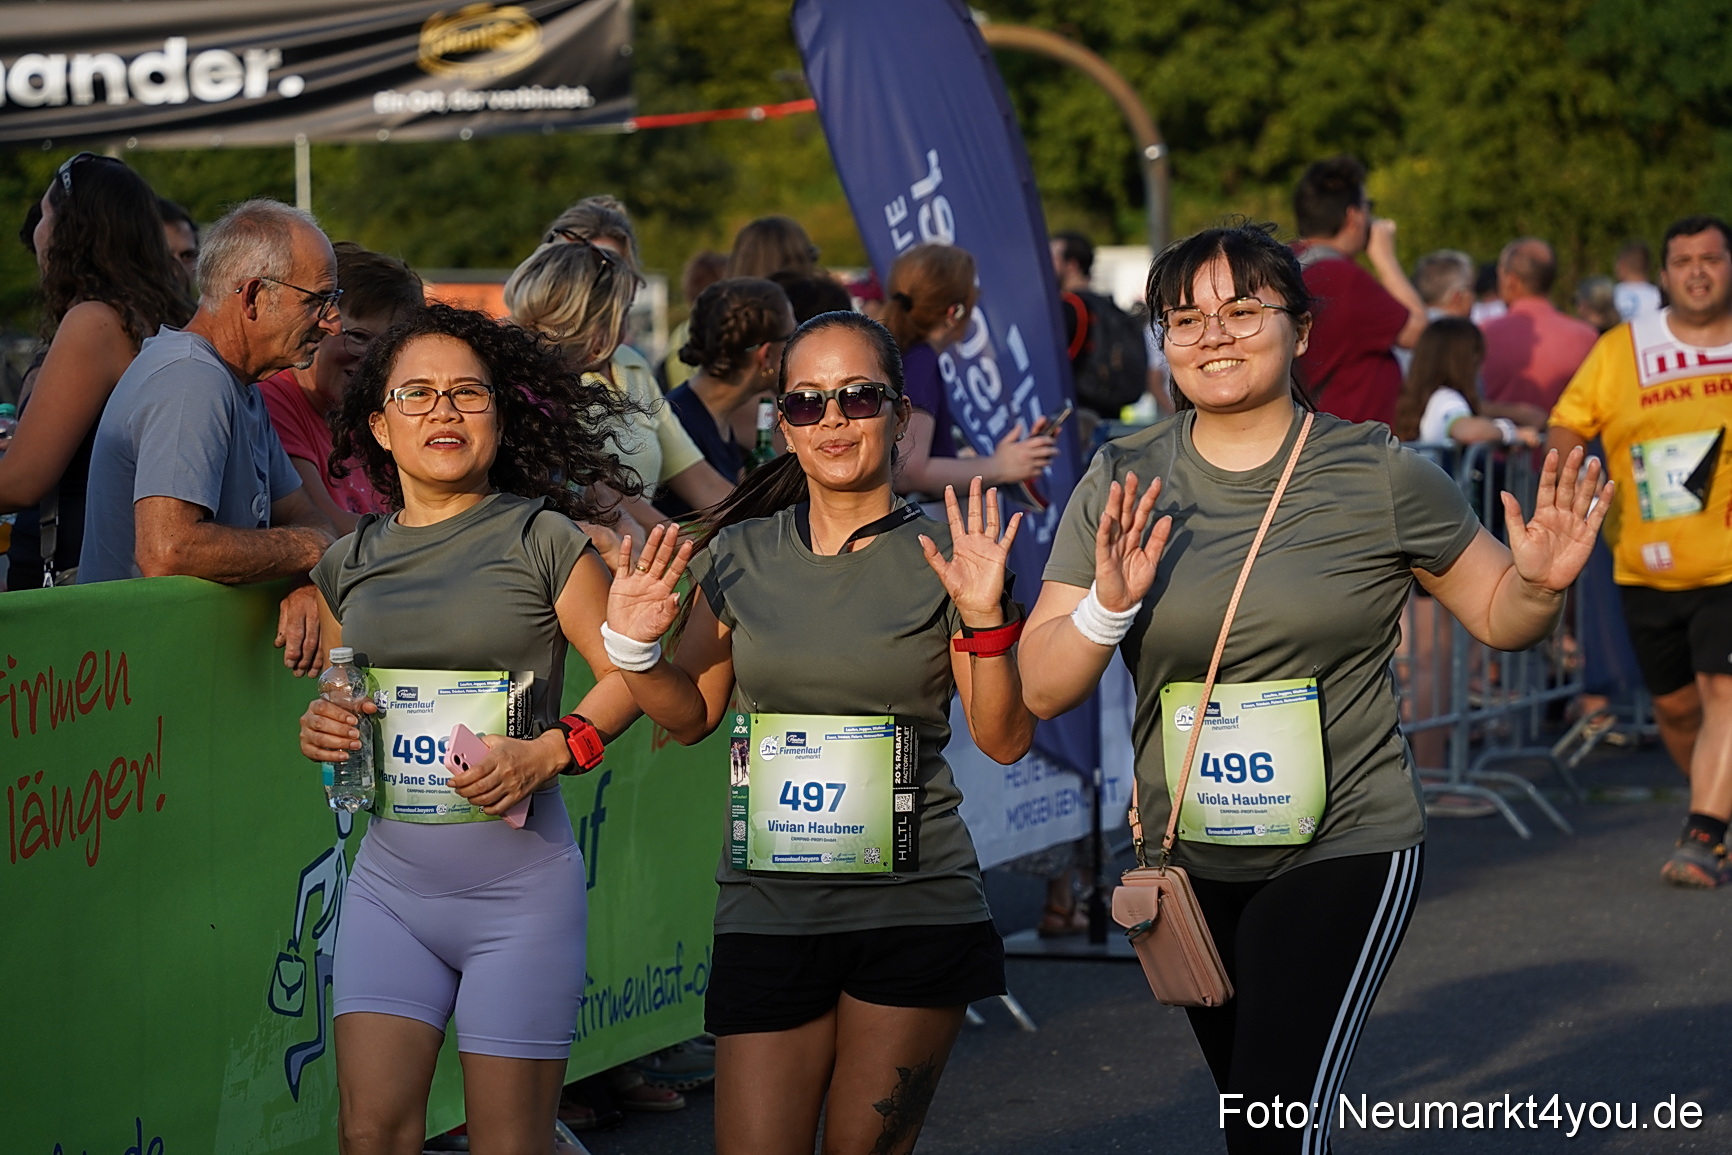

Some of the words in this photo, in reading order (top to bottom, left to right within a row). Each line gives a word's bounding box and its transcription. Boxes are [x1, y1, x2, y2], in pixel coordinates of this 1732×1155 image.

[1640, 383, 1693, 408] MAX
[390, 700, 435, 709] Firmenlauf
[508, 680, 516, 717] RABATT
[1203, 716, 1239, 726] rmenlauf
[508, 725, 515, 737] 20
[732, 725, 748, 734] AOK
[779, 746, 822, 755] Firmenlauf
[895, 725, 903, 762] RABATT
[1200, 751, 1274, 784] 496
[398, 773, 425, 786] Jane
[894, 771, 902, 784] 20
[7, 714, 166, 867] länger!
[779, 780, 847, 812] 497
[1196, 791, 1229, 806] Viola
[1231, 792, 1291, 806] Haubner
[767, 819, 805, 833] Vivian
[808, 821, 865, 834] Haubner
[898, 815, 907, 861] HILTL
